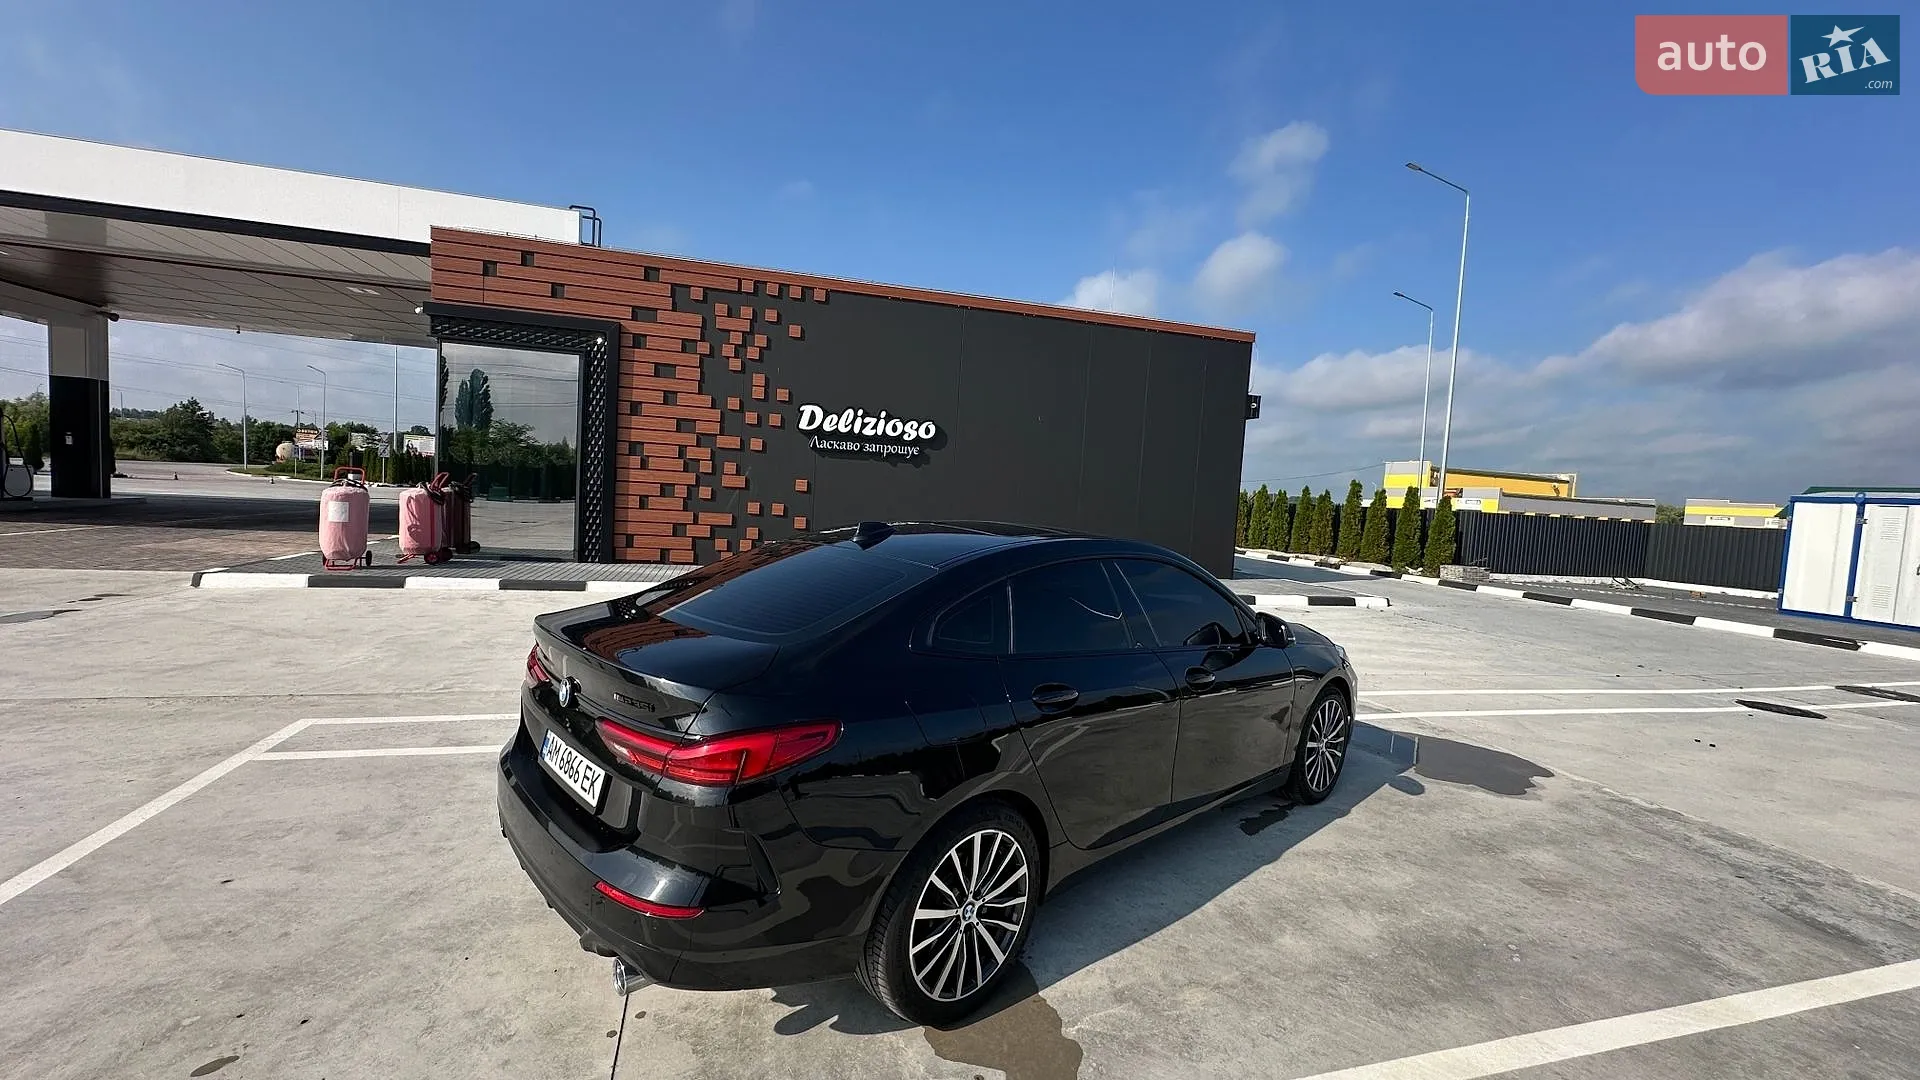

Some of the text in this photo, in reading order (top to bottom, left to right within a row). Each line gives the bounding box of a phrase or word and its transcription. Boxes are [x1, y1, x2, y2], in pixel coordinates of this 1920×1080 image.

[798, 404, 936, 441] Delizioso
[809, 435, 920, 459] Ласкаво запрошує
[547, 736, 602, 800] AM 6866 EK
